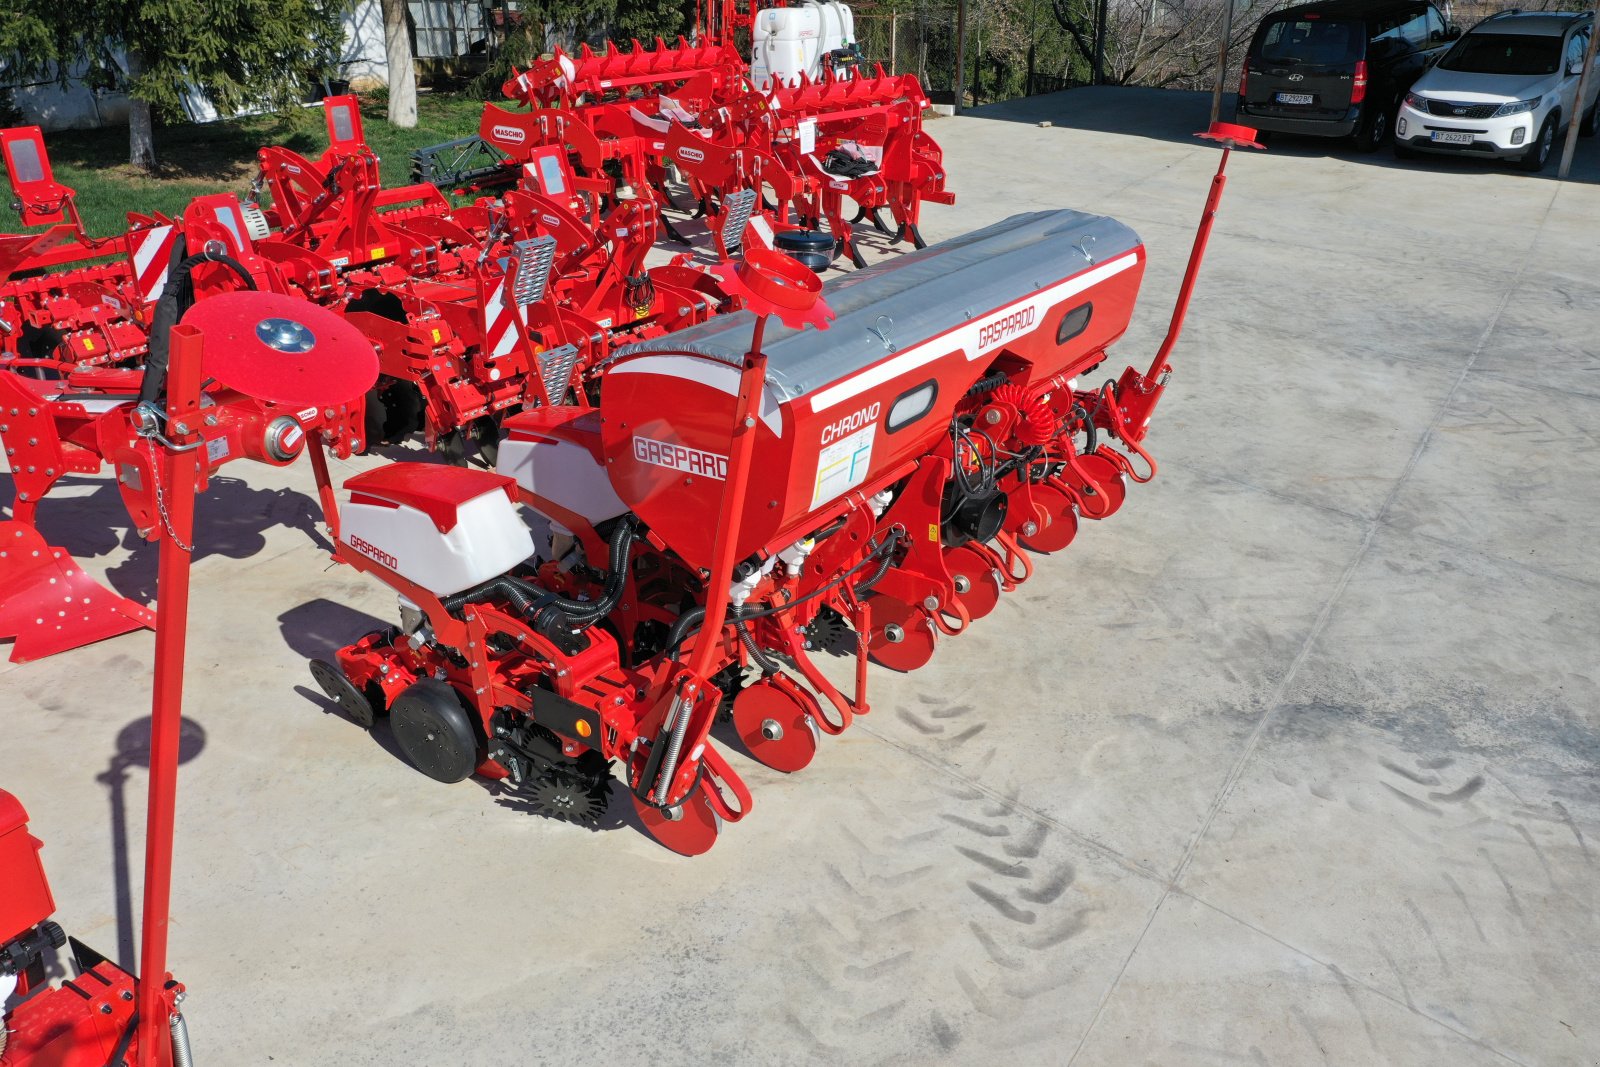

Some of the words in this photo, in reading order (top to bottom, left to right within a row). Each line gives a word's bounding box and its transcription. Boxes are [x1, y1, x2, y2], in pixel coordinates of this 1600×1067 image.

[495, 128, 523, 139] MASCHIO
[680, 149, 702, 159] MASCHIO
[979, 305, 1034, 349] GASPARDO
[820, 401, 880, 445] CHRONO
[634, 438, 728, 479] GASPARD
[351, 534, 397, 569] GASPARDO
